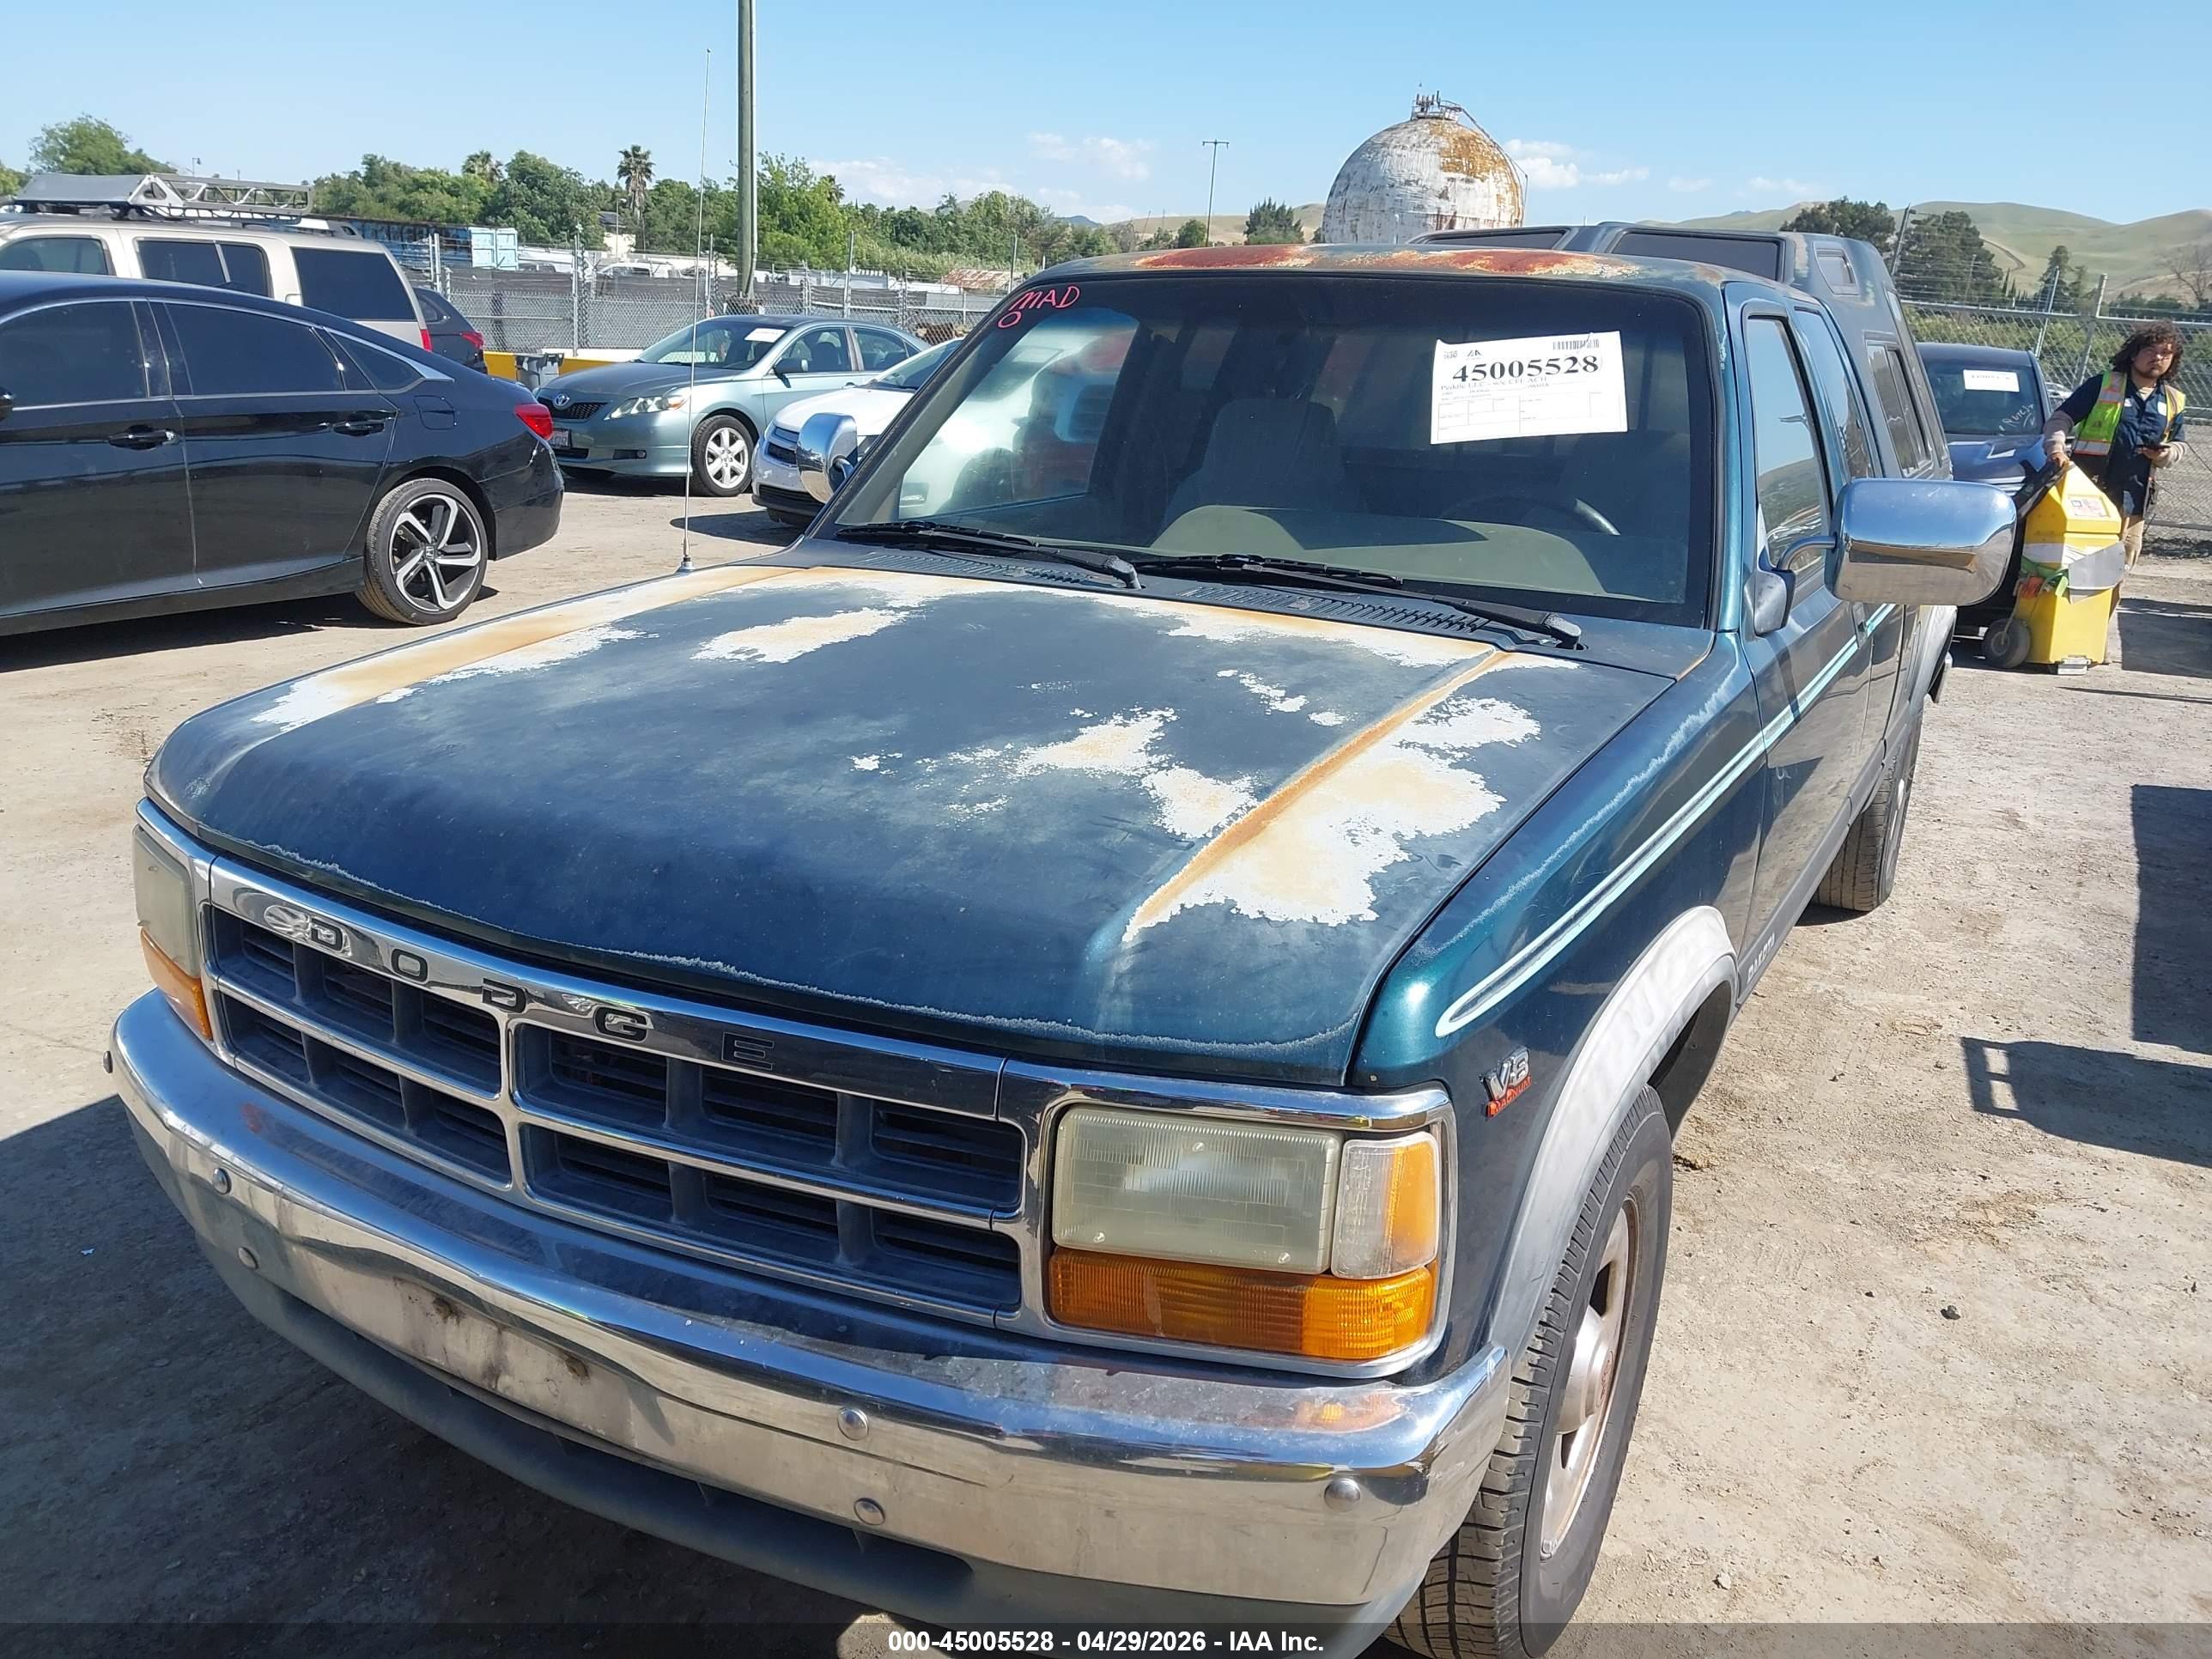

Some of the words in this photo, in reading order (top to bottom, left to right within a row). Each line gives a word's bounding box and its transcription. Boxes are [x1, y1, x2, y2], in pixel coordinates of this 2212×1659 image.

[1008, 285, 1080, 311] MAD
[1452, 356, 1598, 382] 45005528
[309, 917, 775, 1072] DODGE
[1481, 1046, 1529, 1100] V8
